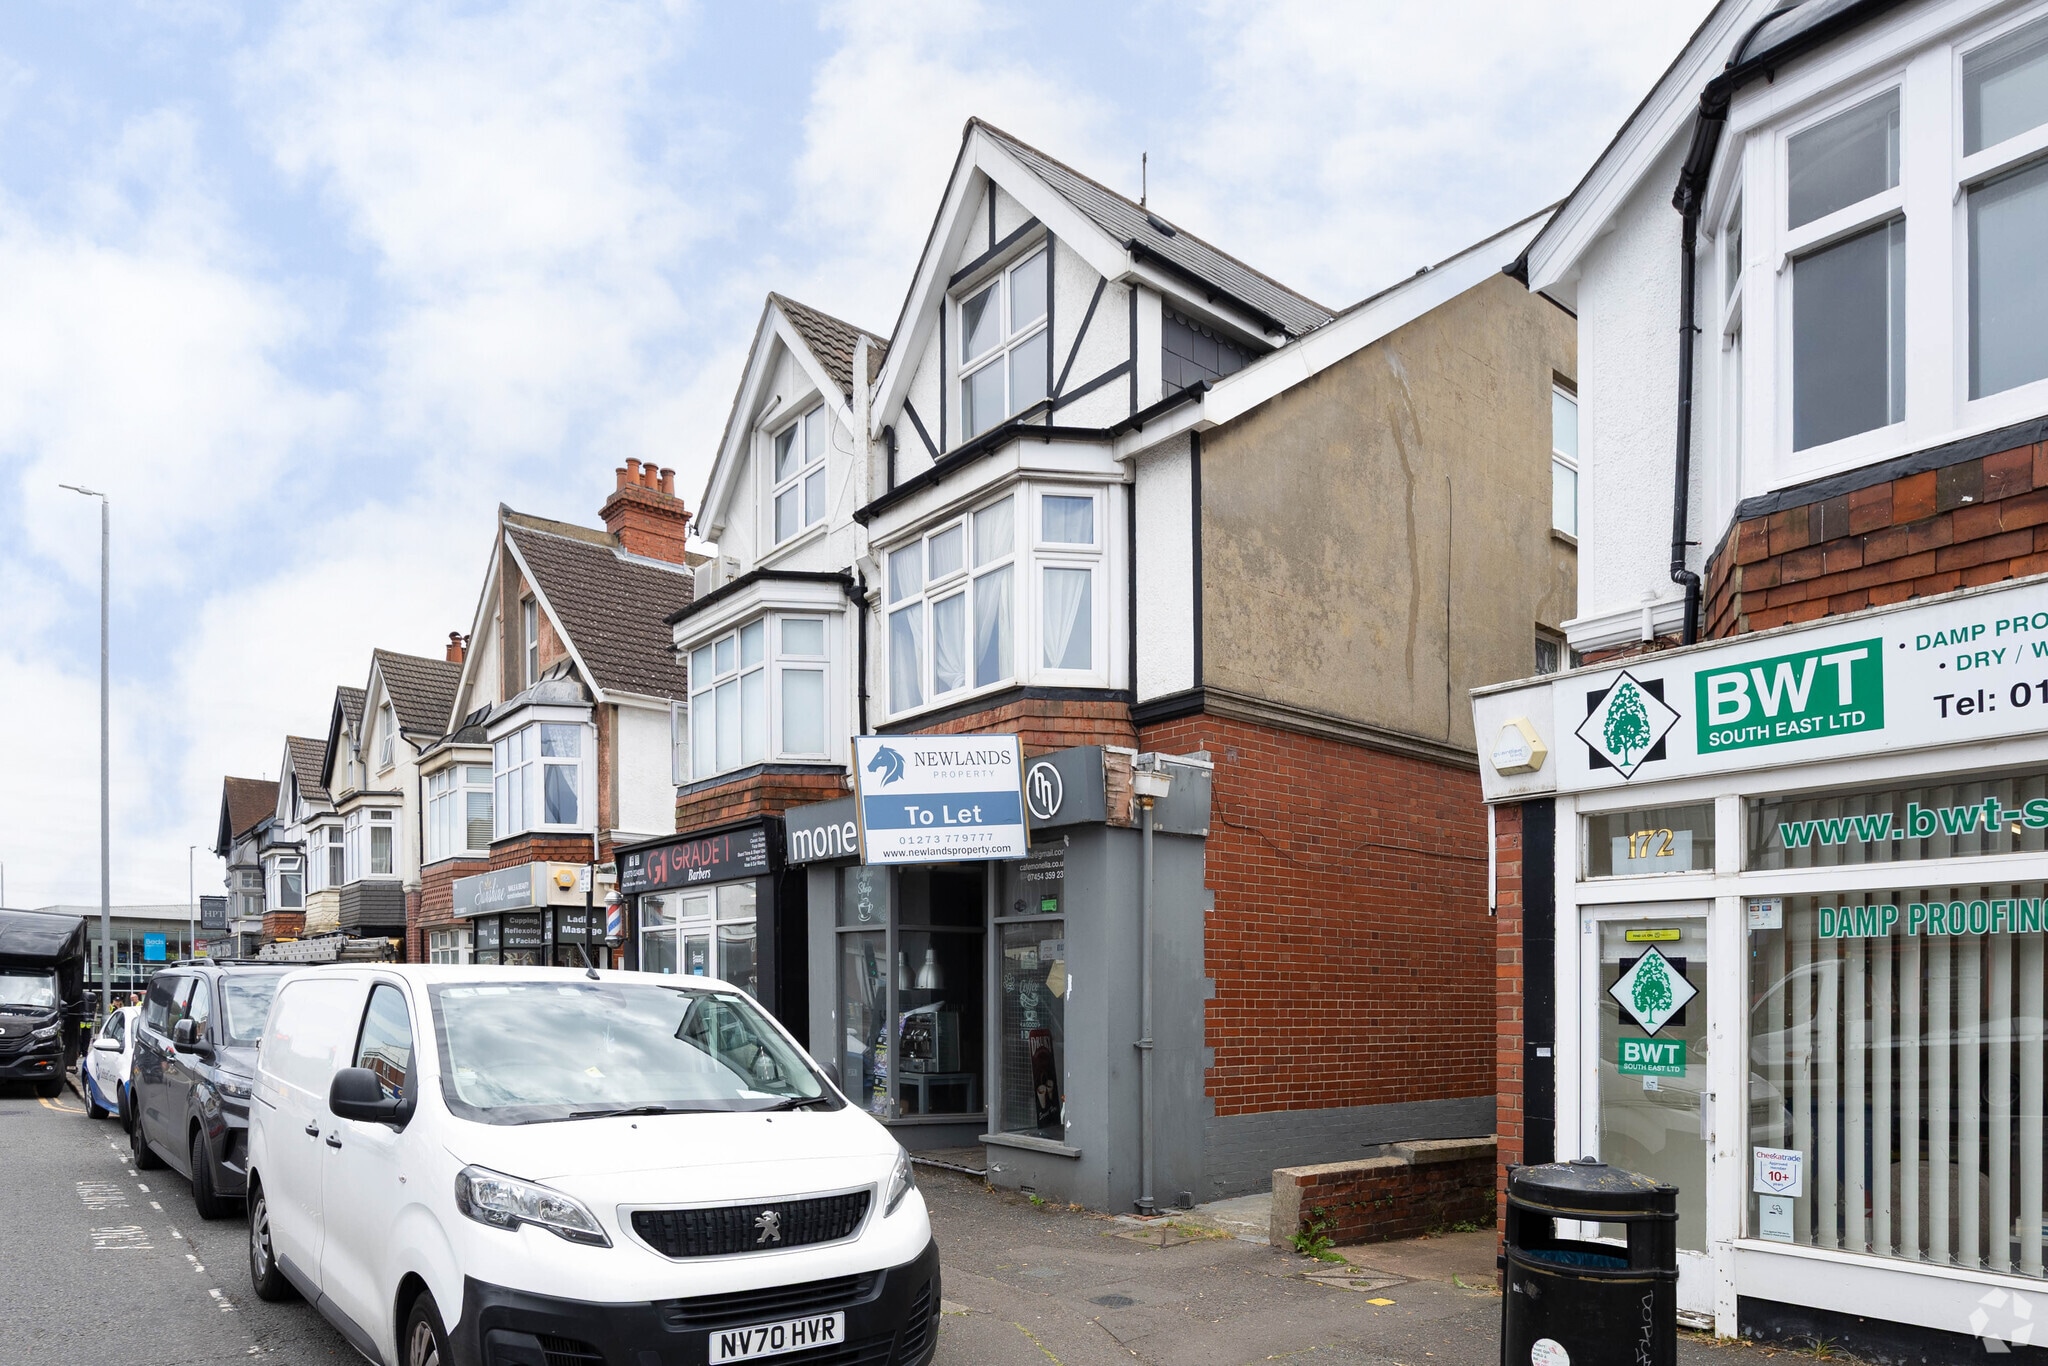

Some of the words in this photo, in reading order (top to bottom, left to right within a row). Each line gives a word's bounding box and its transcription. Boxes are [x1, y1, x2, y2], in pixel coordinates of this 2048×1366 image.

[1916, 624, 1986, 651] DAMP
[1995, 612, 2048, 636] PRO
[1956, 647, 2007, 671] DRY
[1707, 647, 1868, 726] BWT
[1933, 689, 1996, 718] Tel:
[2010, 679, 2048, 708] 01
[1709, 724, 1770, 747] SOUTH
[1775, 716, 1824, 737] EAST
[1829, 710, 1866, 729] LTD
[914, 750, 1011, 767] NEWLANDS
[933, 770, 995, 779] PROPERTY
[904, 806, 934, 825] To
[943, 805, 982, 824] Let
[899, 835, 941, 845] 01273
[945, 833, 993, 843] 779777
[1627, 828, 1674, 859] 172
[671, 838, 720, 871] GRADE
[724, 835, 729, 862] 1
[883, 844, 1012, 859] www.newlandsproperty.com
[688, 867, 711, 881] Barbers
[858, 880, 872, 896] Shop
[204, 910, 224, 918] HPT
[567, 915, 597, 923] Ladis
[1819, 904, 1899, 939] DAMP
[562, 925, 602, 936] Massge
[1020, 979, 1040, 995] Coffee
[1624, 1042, 1680, 1064] BWT
[1623, 1063, 1647, 1071] SOUTH
[1756, 1151, 1801, 1163] Checkatrade
[1768, 1170, 1789, 1181] 10+
[720, 1326, 785, 1359] NV70
[792, 1316, 836, 1346] HVR
